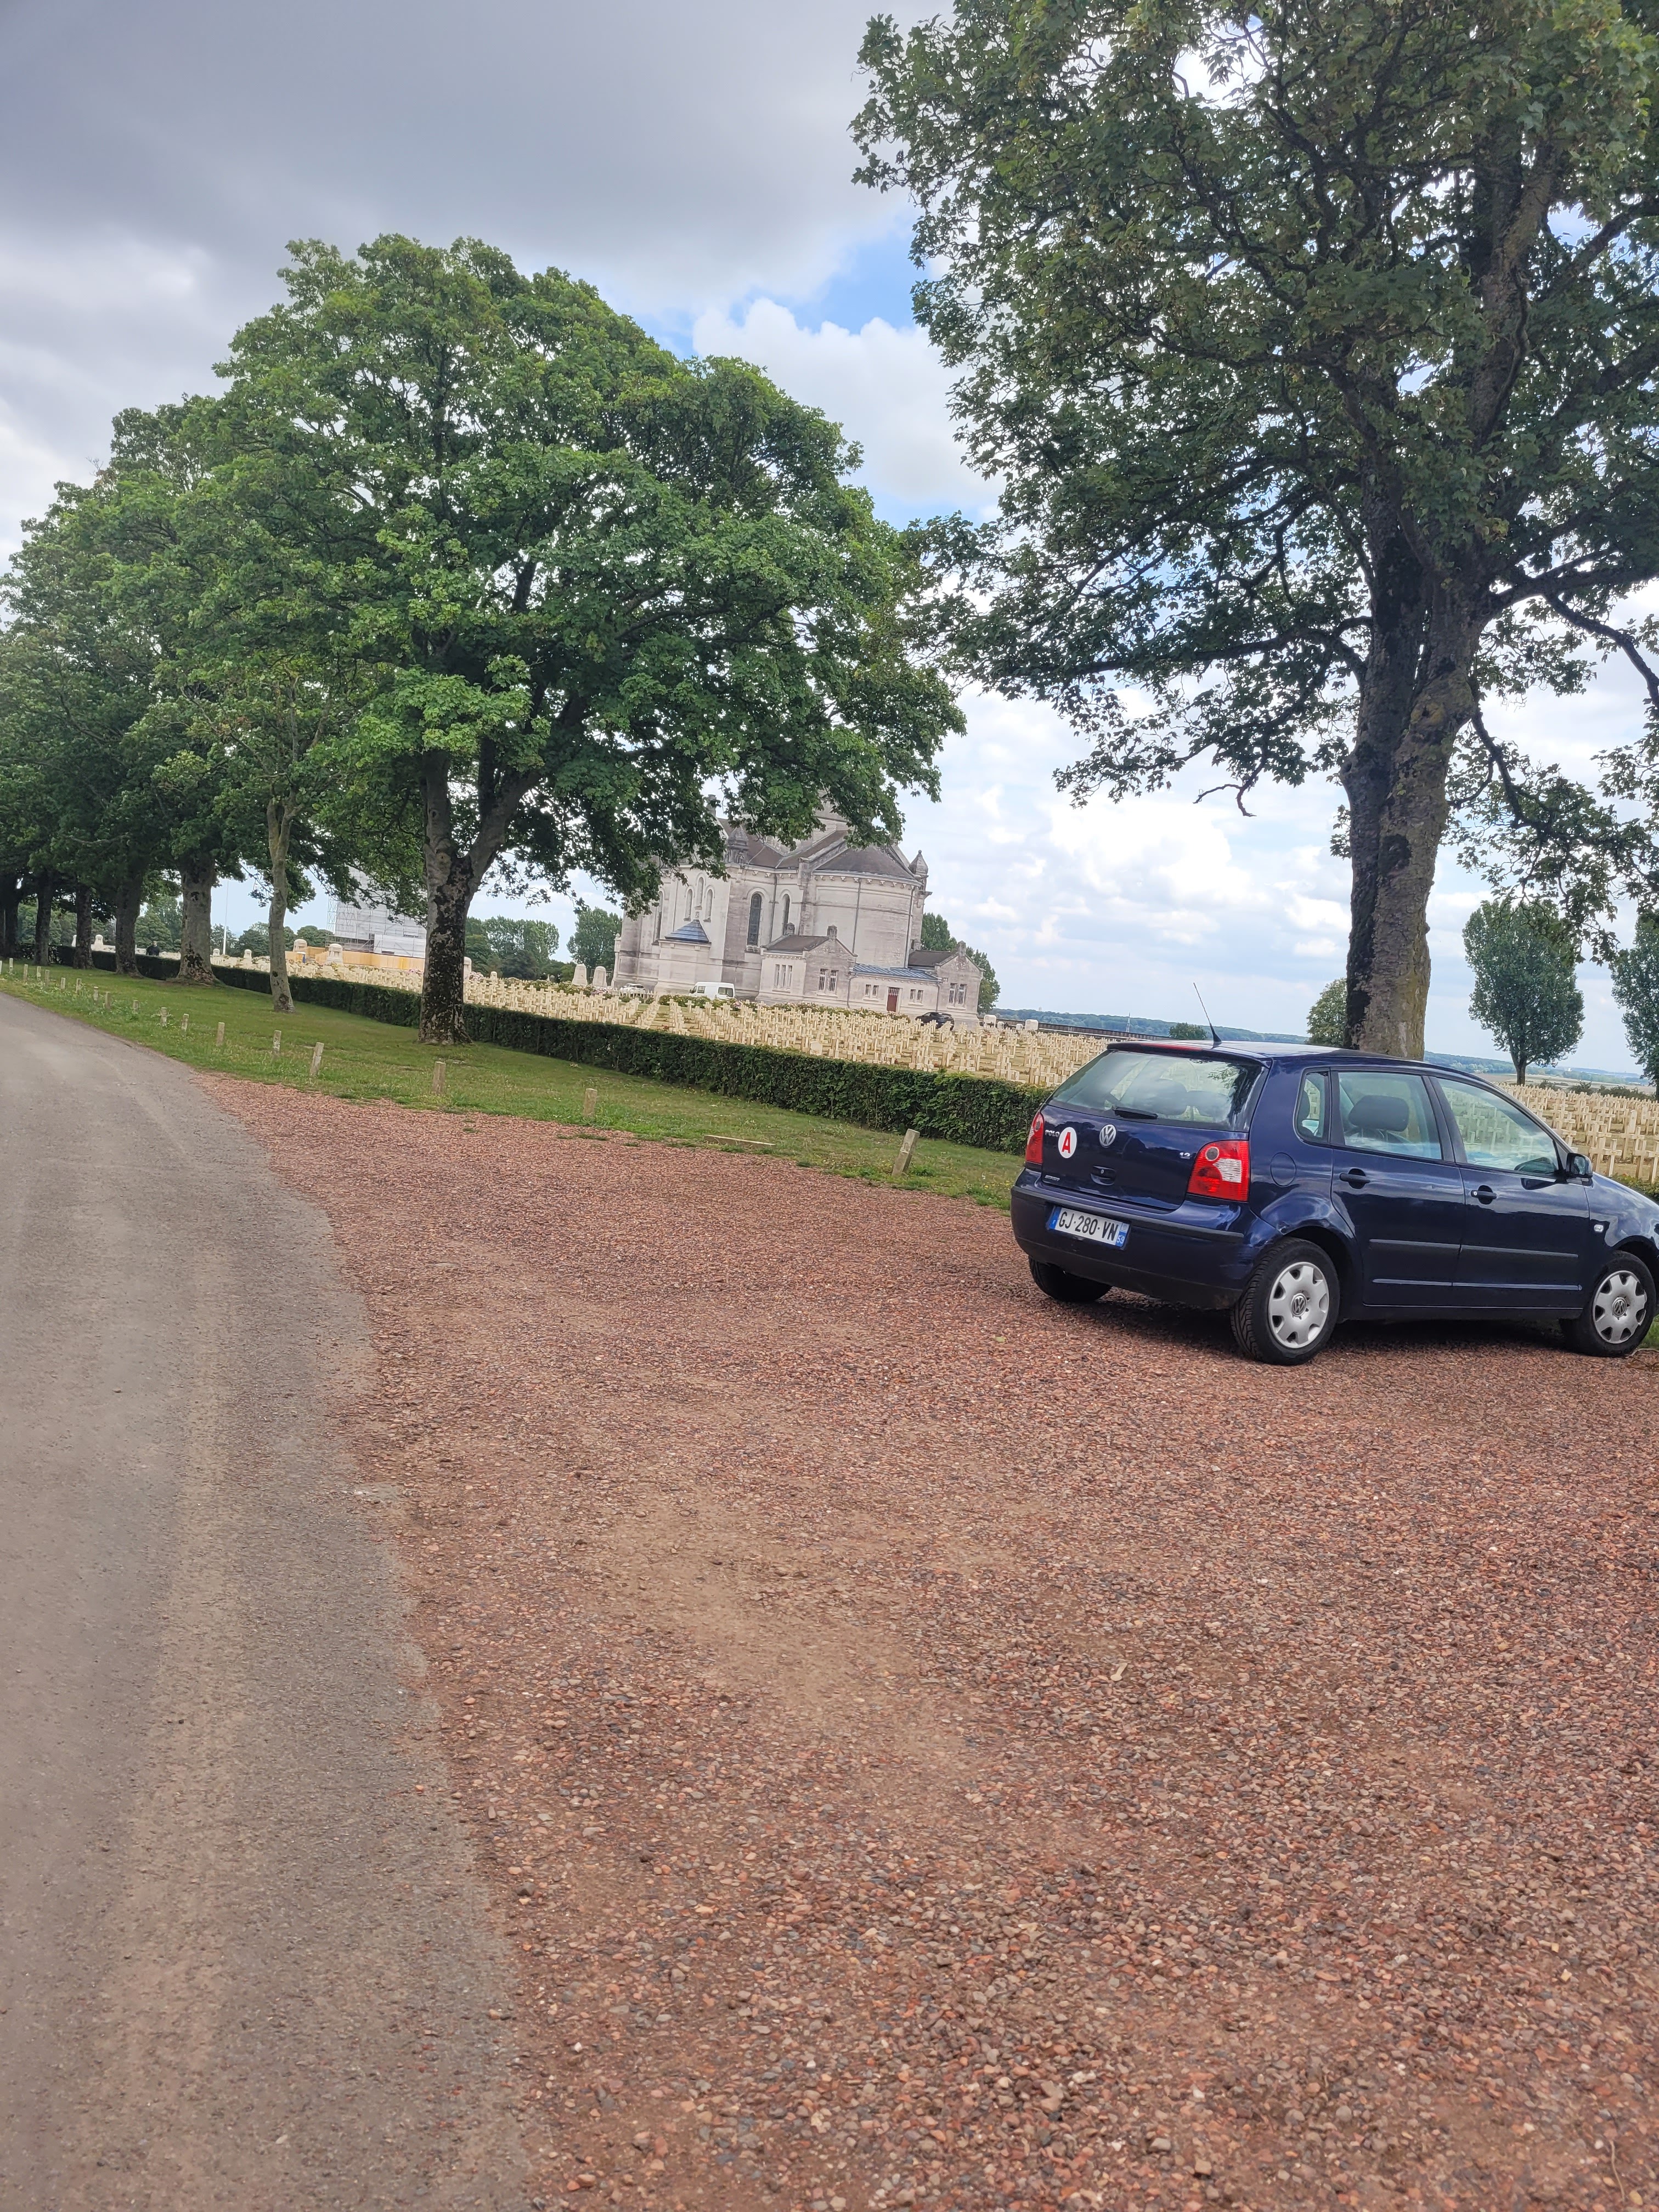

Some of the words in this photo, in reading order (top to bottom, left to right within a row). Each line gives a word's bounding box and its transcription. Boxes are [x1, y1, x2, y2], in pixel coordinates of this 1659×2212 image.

[1045, 1129, 1060, 1137] POLO
[1062, 1131, 1071, 1154] A
[1116, 1234, 1125, 1244] 59
